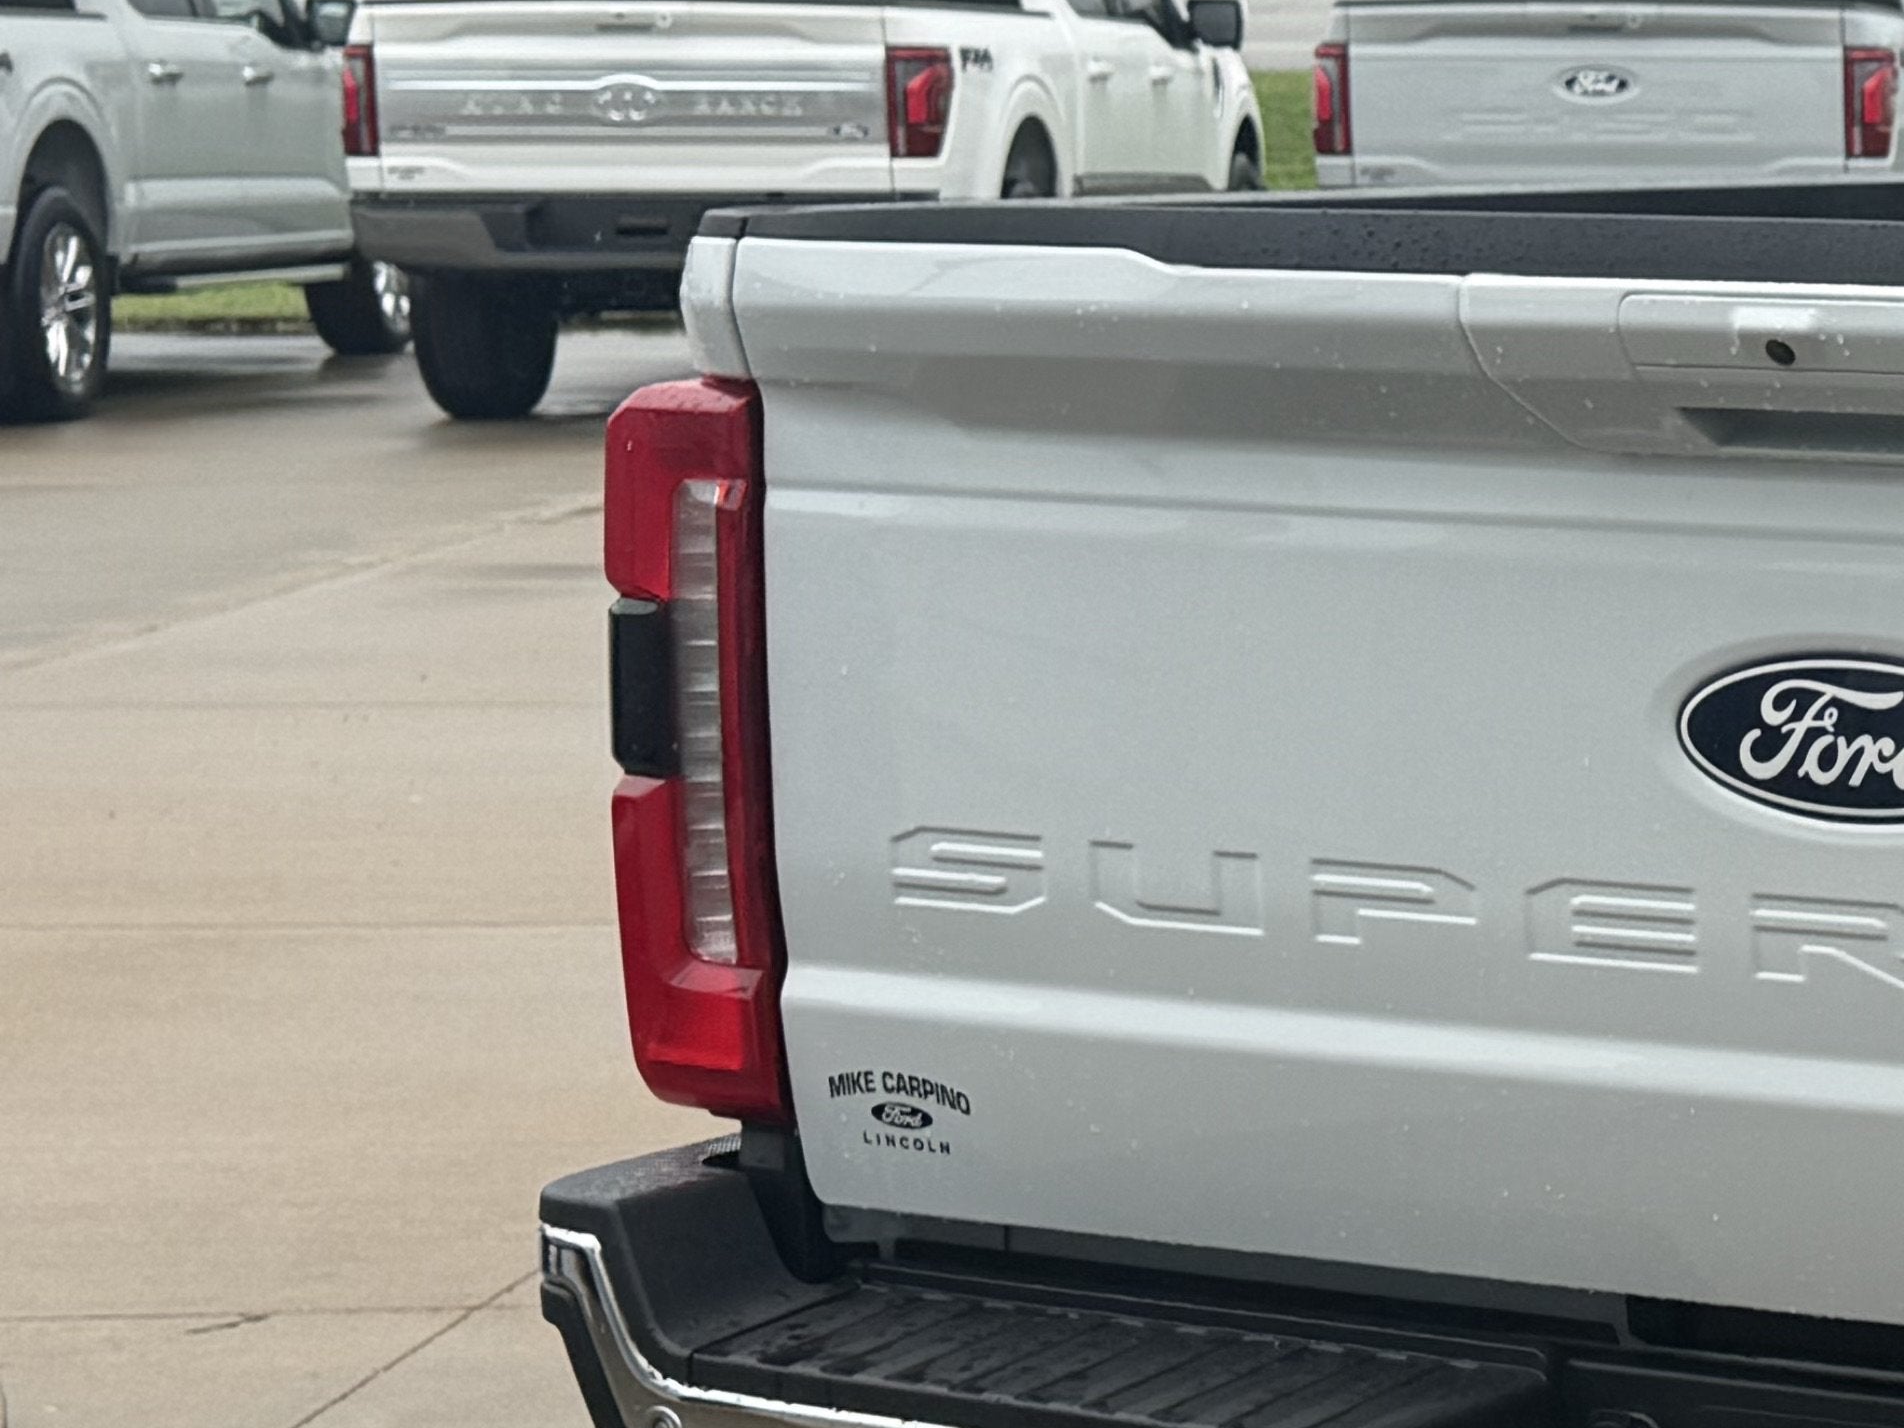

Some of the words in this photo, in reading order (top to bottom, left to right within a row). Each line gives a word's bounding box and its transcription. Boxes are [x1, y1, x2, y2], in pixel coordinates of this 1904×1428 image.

[828, 1070, 876, 1099] MIKE
[881, 1071, 972, 1116] CARPINO
[881, 1103, 924, 1128] Ford
[862, 1129, 951, 1155] LINCOLN
